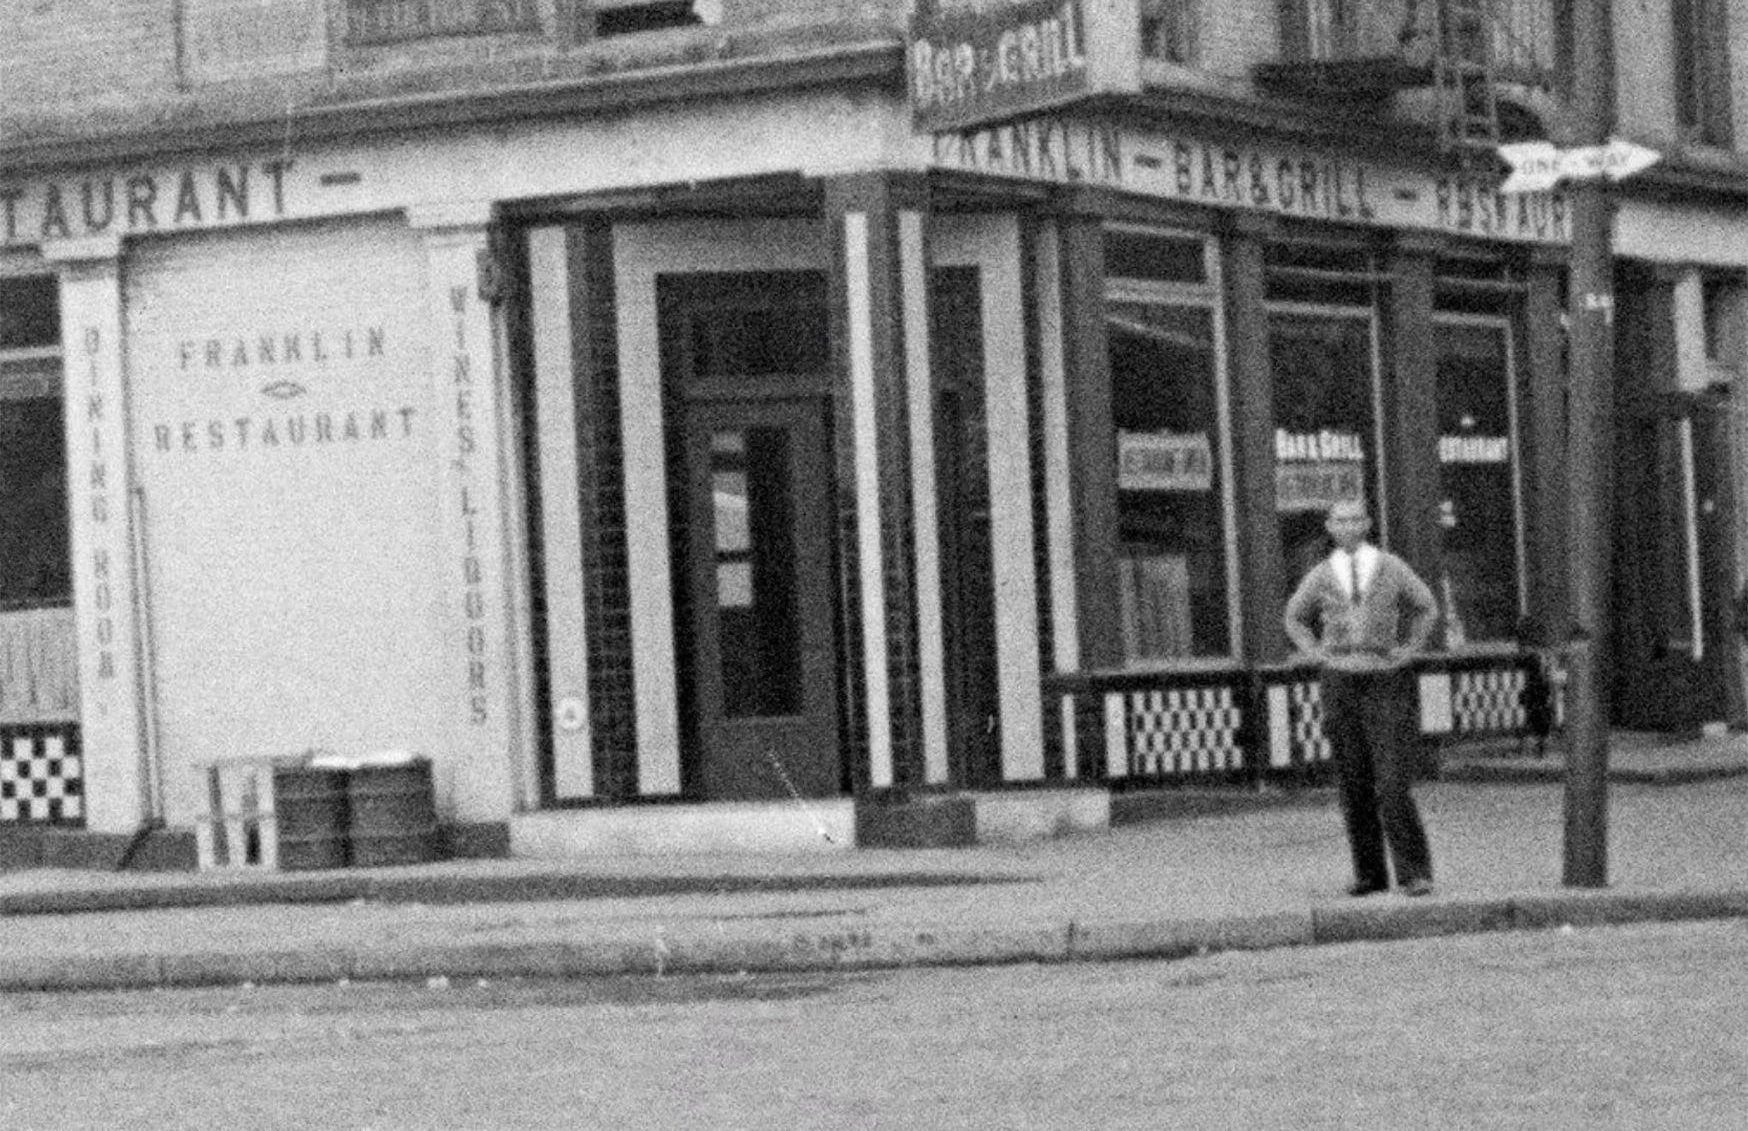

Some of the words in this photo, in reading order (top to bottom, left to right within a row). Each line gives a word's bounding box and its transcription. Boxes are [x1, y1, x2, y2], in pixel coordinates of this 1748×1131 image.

[999, 0, 1084, 83] GRILL
[179, 326, 385, 371] FRANKLIN
[449, 286, 476, 454] WINES
[84, 326, 108, 522] DINING
[153, 406, 416, 454] RESTAURANT
[94, 548, 115, 679] ROOM
[460, 487, 488, 726] LIQUORS
